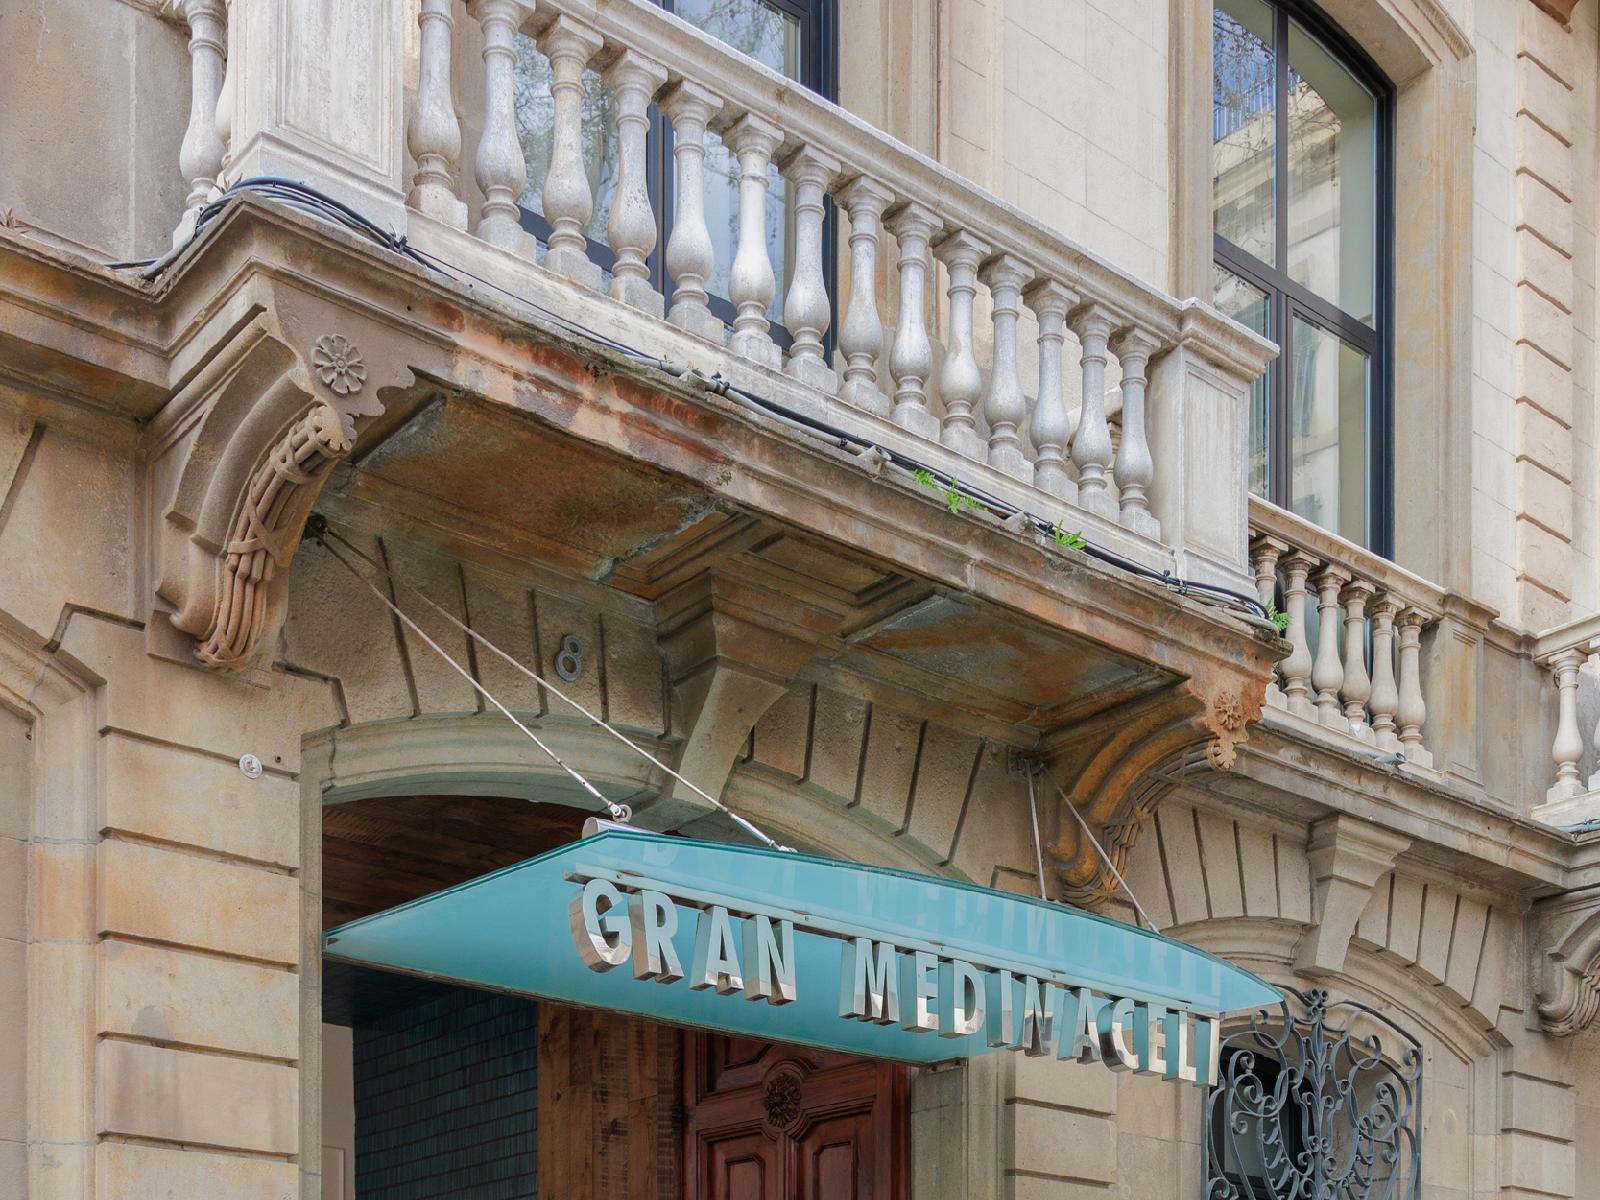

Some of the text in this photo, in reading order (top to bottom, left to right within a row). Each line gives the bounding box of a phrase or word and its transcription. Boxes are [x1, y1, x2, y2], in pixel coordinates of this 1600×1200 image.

[555, 635, 582, 682] 8
[568, 878, 1220, 1087] GRAN MEDINACELI
